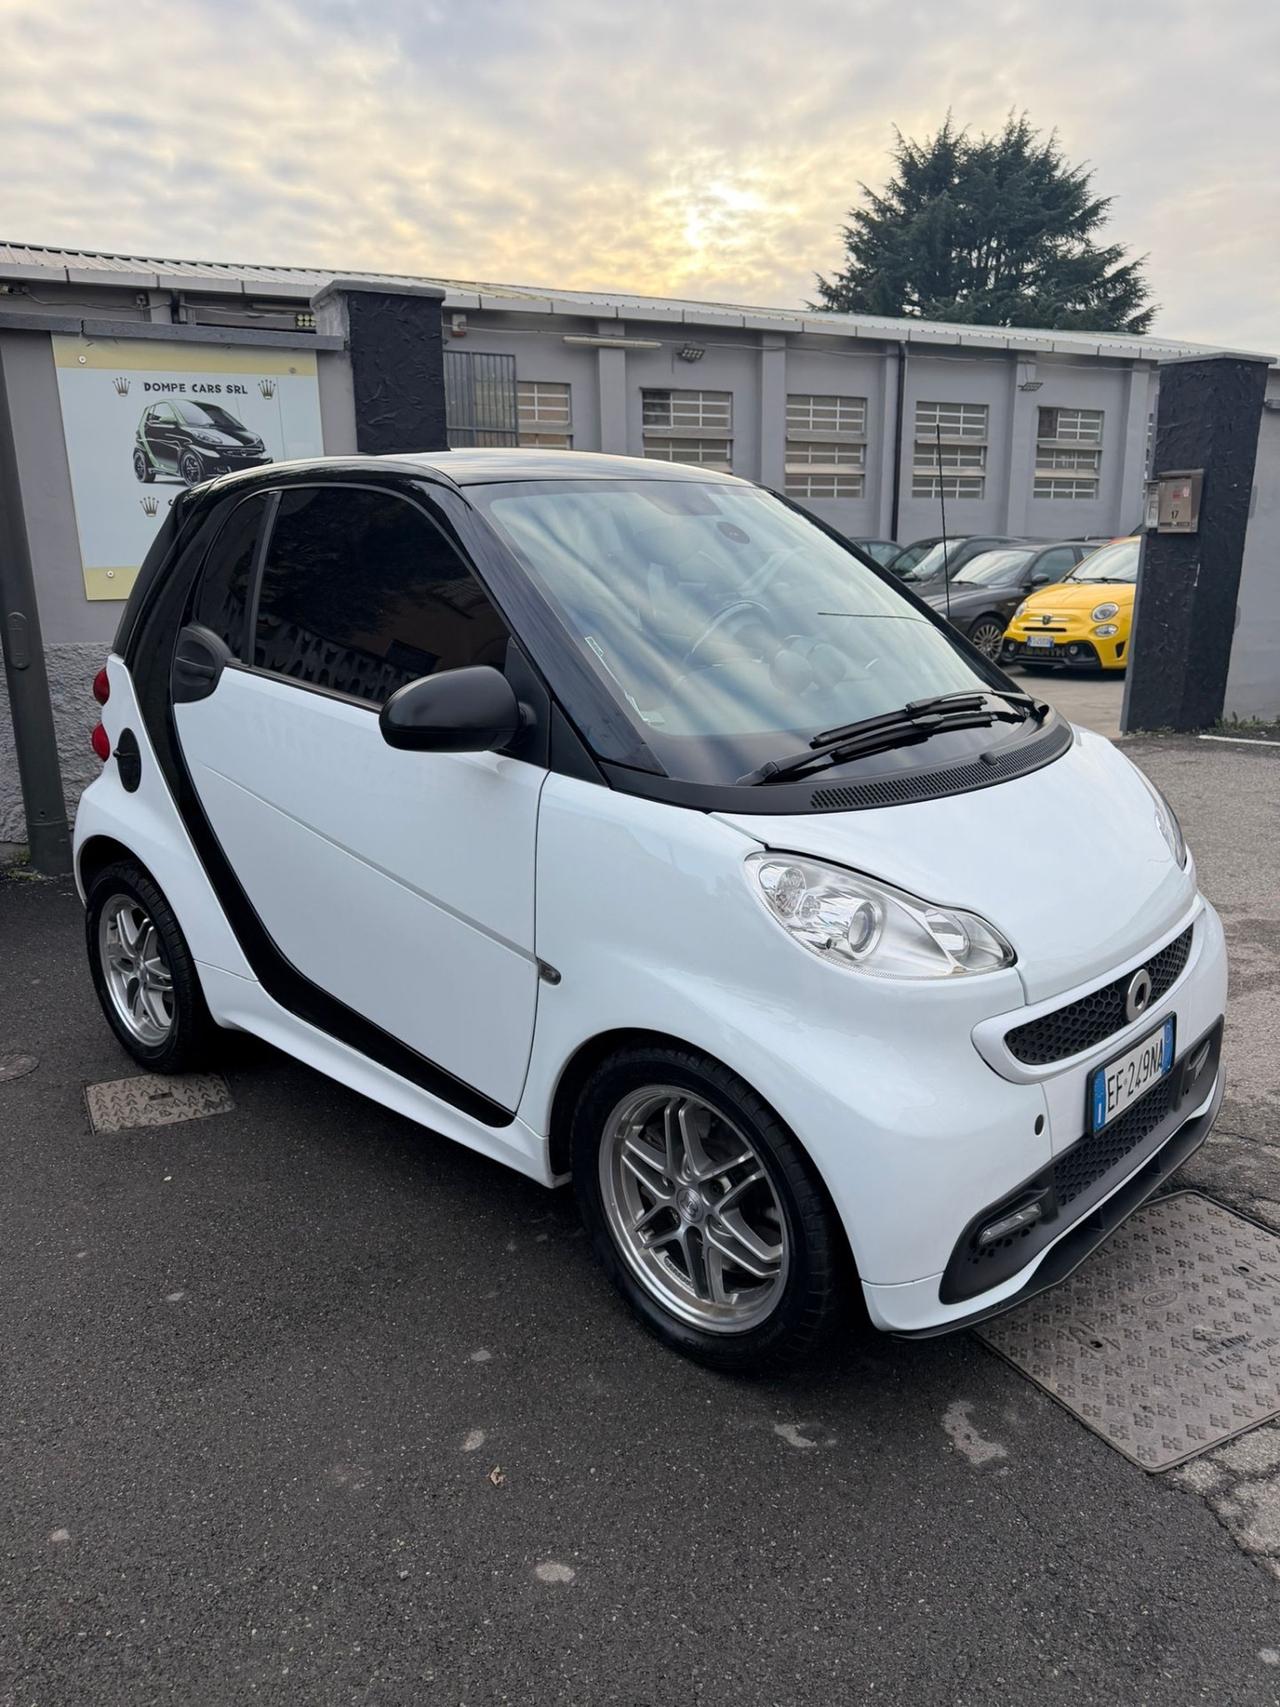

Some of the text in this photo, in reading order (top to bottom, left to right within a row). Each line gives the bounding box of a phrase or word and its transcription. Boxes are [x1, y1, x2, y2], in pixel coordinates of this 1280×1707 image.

[144, 382, 248, 394] DOMPE CARS SRL
[1171, 510, 1180, 520] 17
